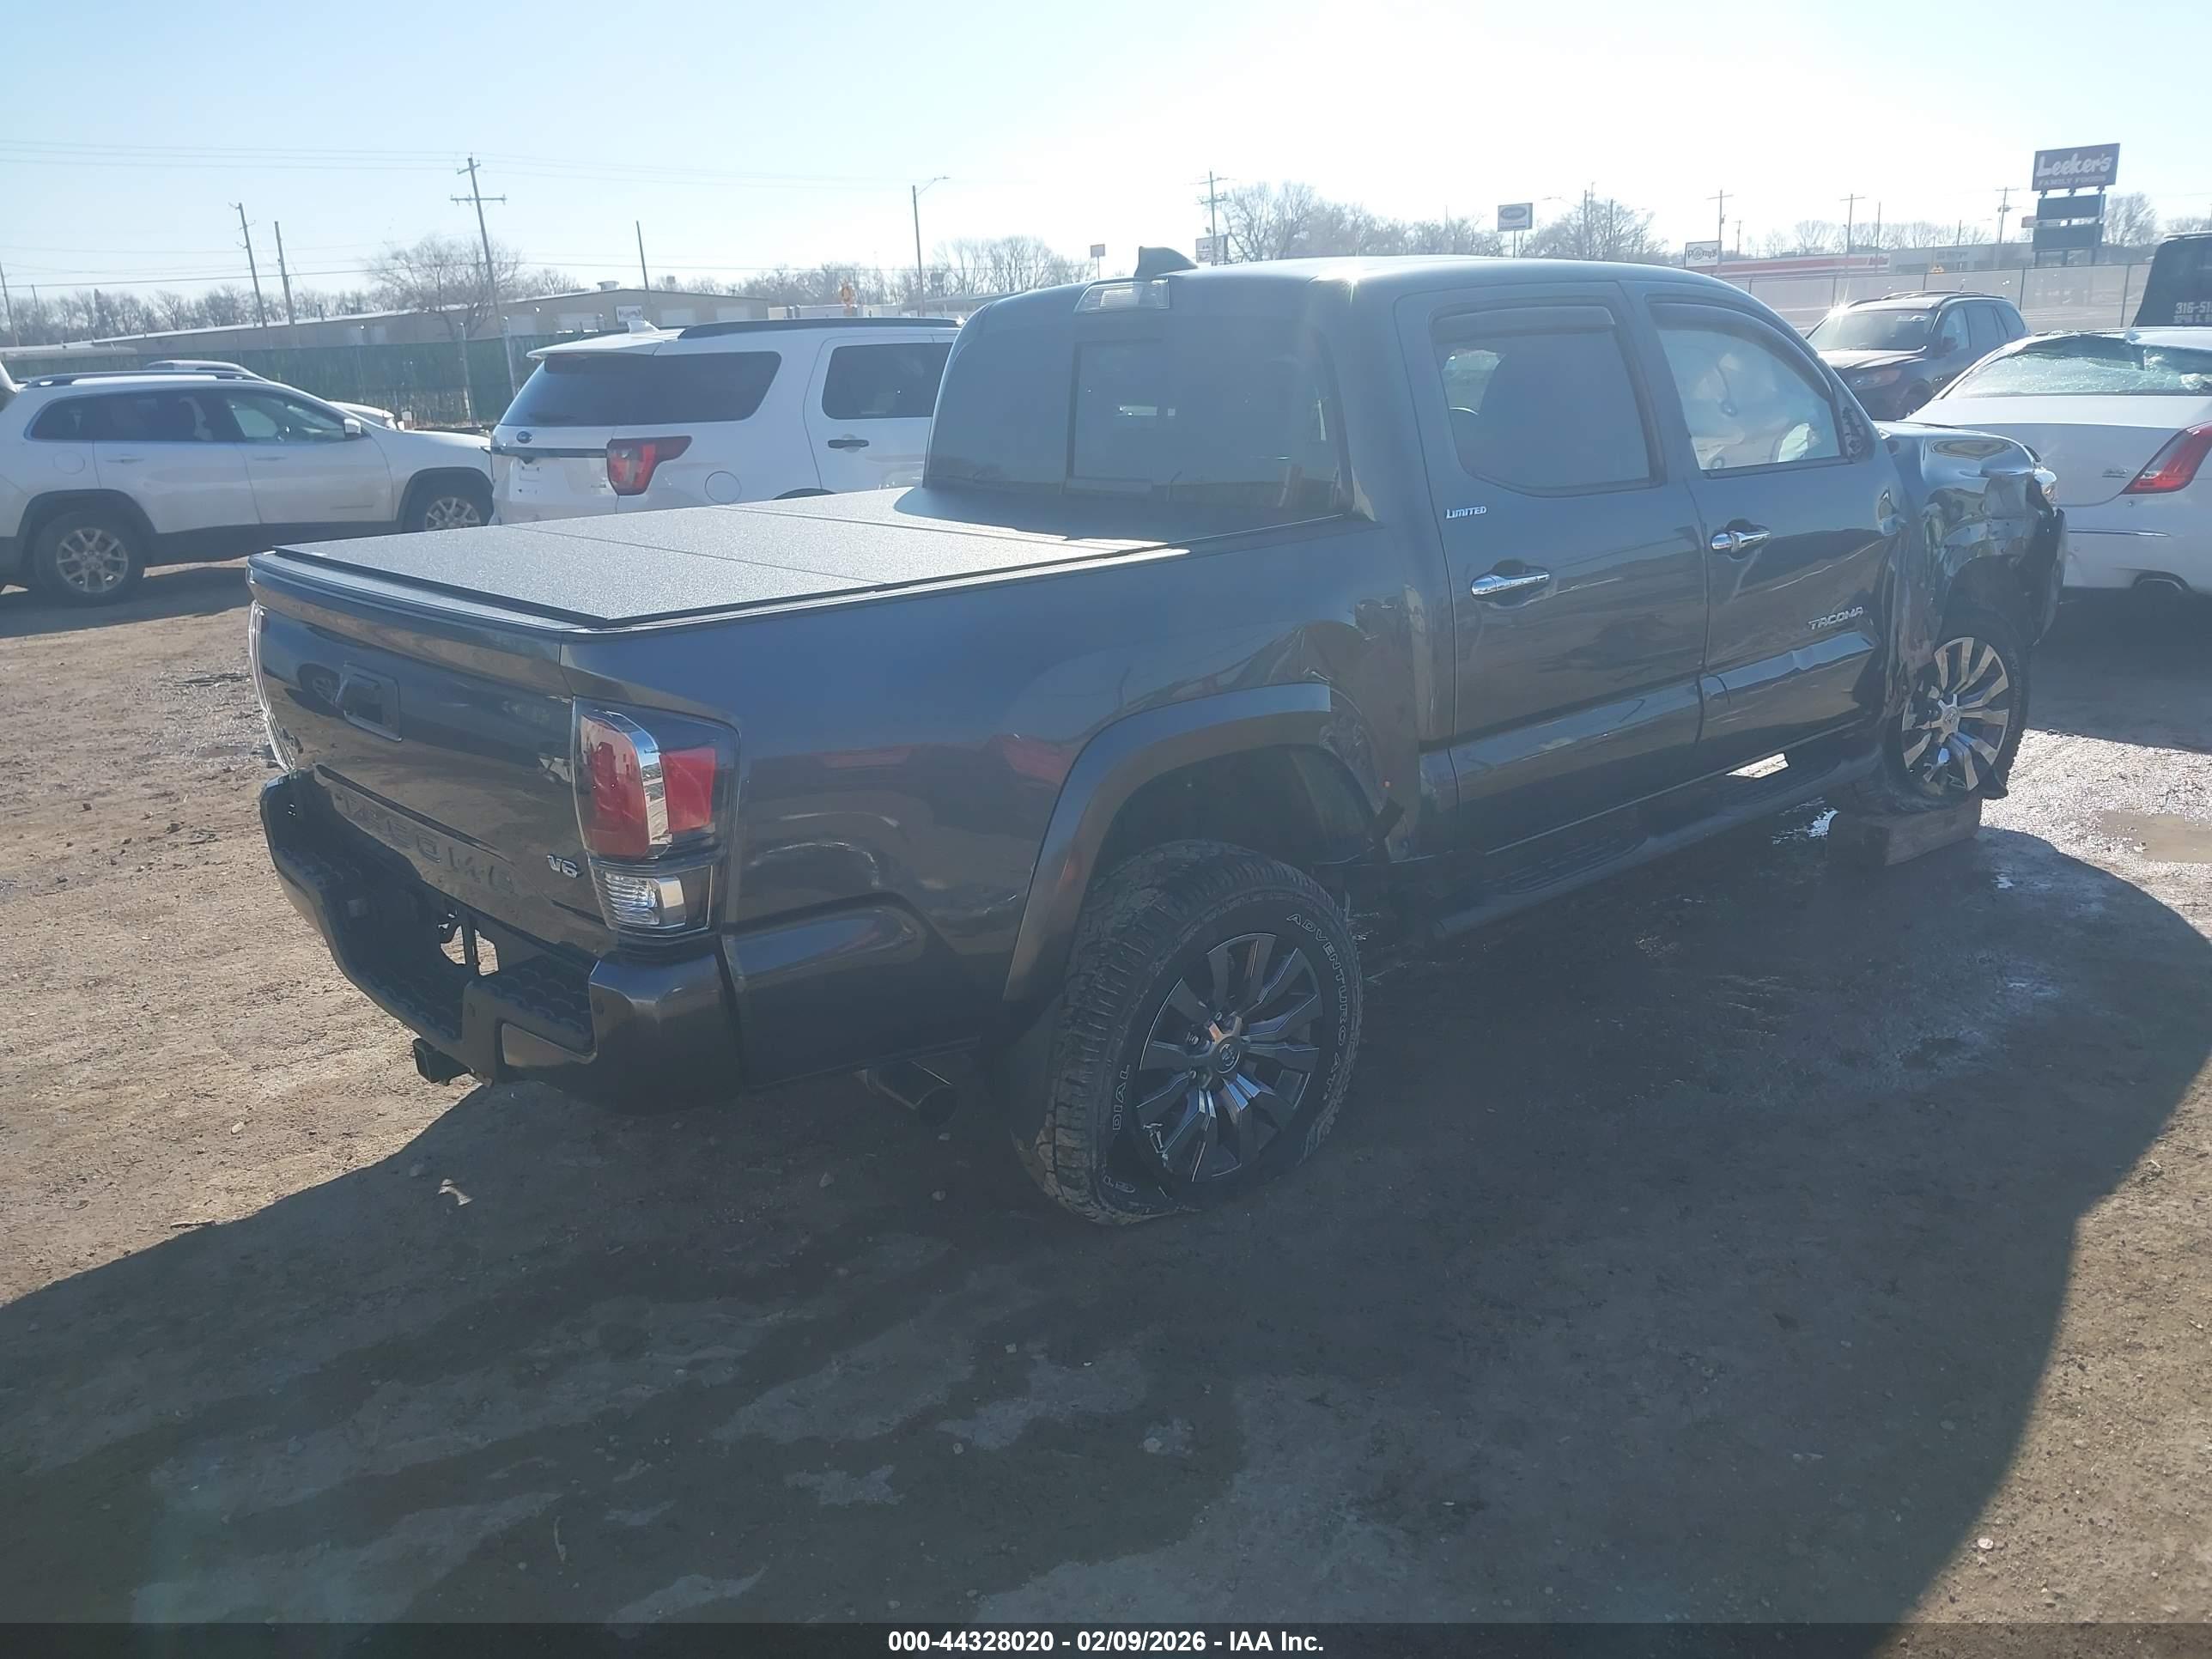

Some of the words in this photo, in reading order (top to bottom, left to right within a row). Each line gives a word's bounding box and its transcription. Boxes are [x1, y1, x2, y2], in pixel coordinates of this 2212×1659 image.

[2036, 153, 2113, 177] Leeker's
[1446, 506, 1487, 520] LIMITED
[1808, 606, 1863, 630] TACOMA
[546, 854, 578, 878] V6
[1286, 913, 1348, 1047] ADVENTURO
